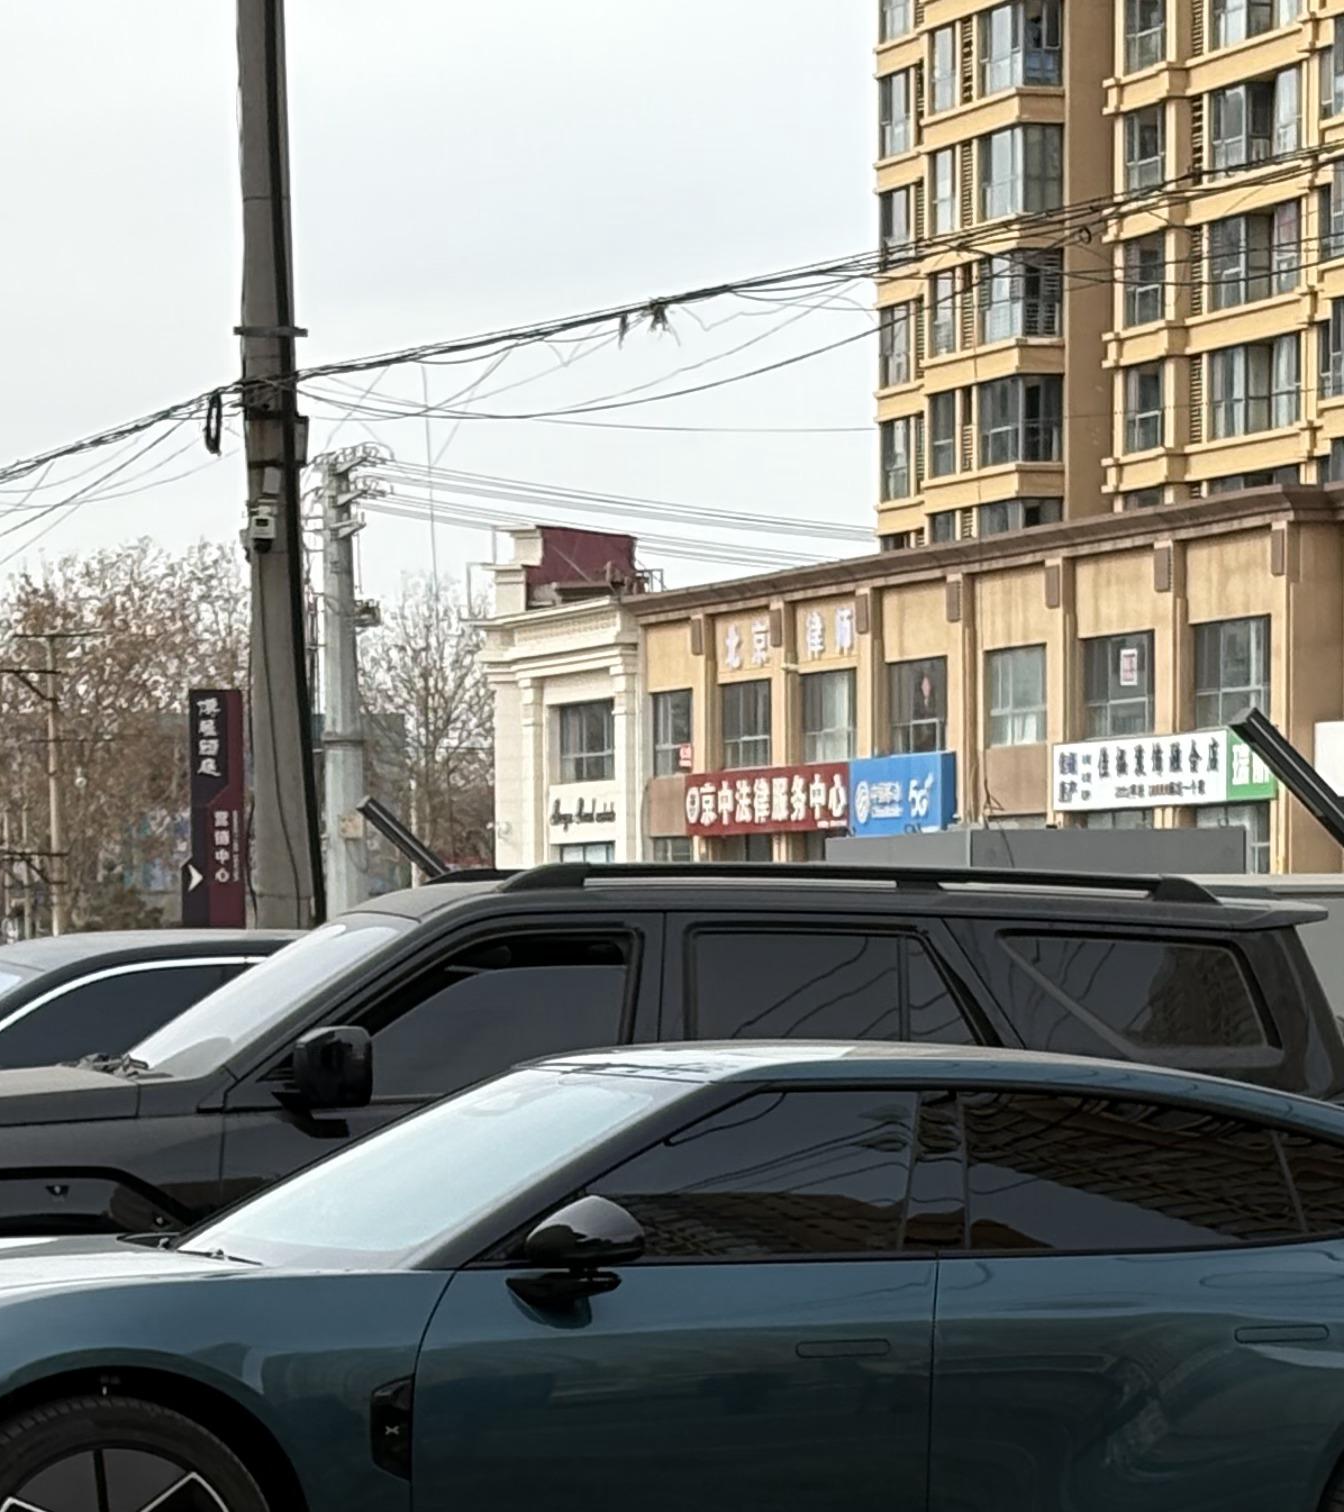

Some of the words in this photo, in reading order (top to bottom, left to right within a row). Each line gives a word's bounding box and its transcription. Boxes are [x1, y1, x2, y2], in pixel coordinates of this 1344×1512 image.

[724, 621, 769, 668] 北京
[806, 606, 853, 660] 律师
[699, 773, 846, 825] 京中法律服务中心
